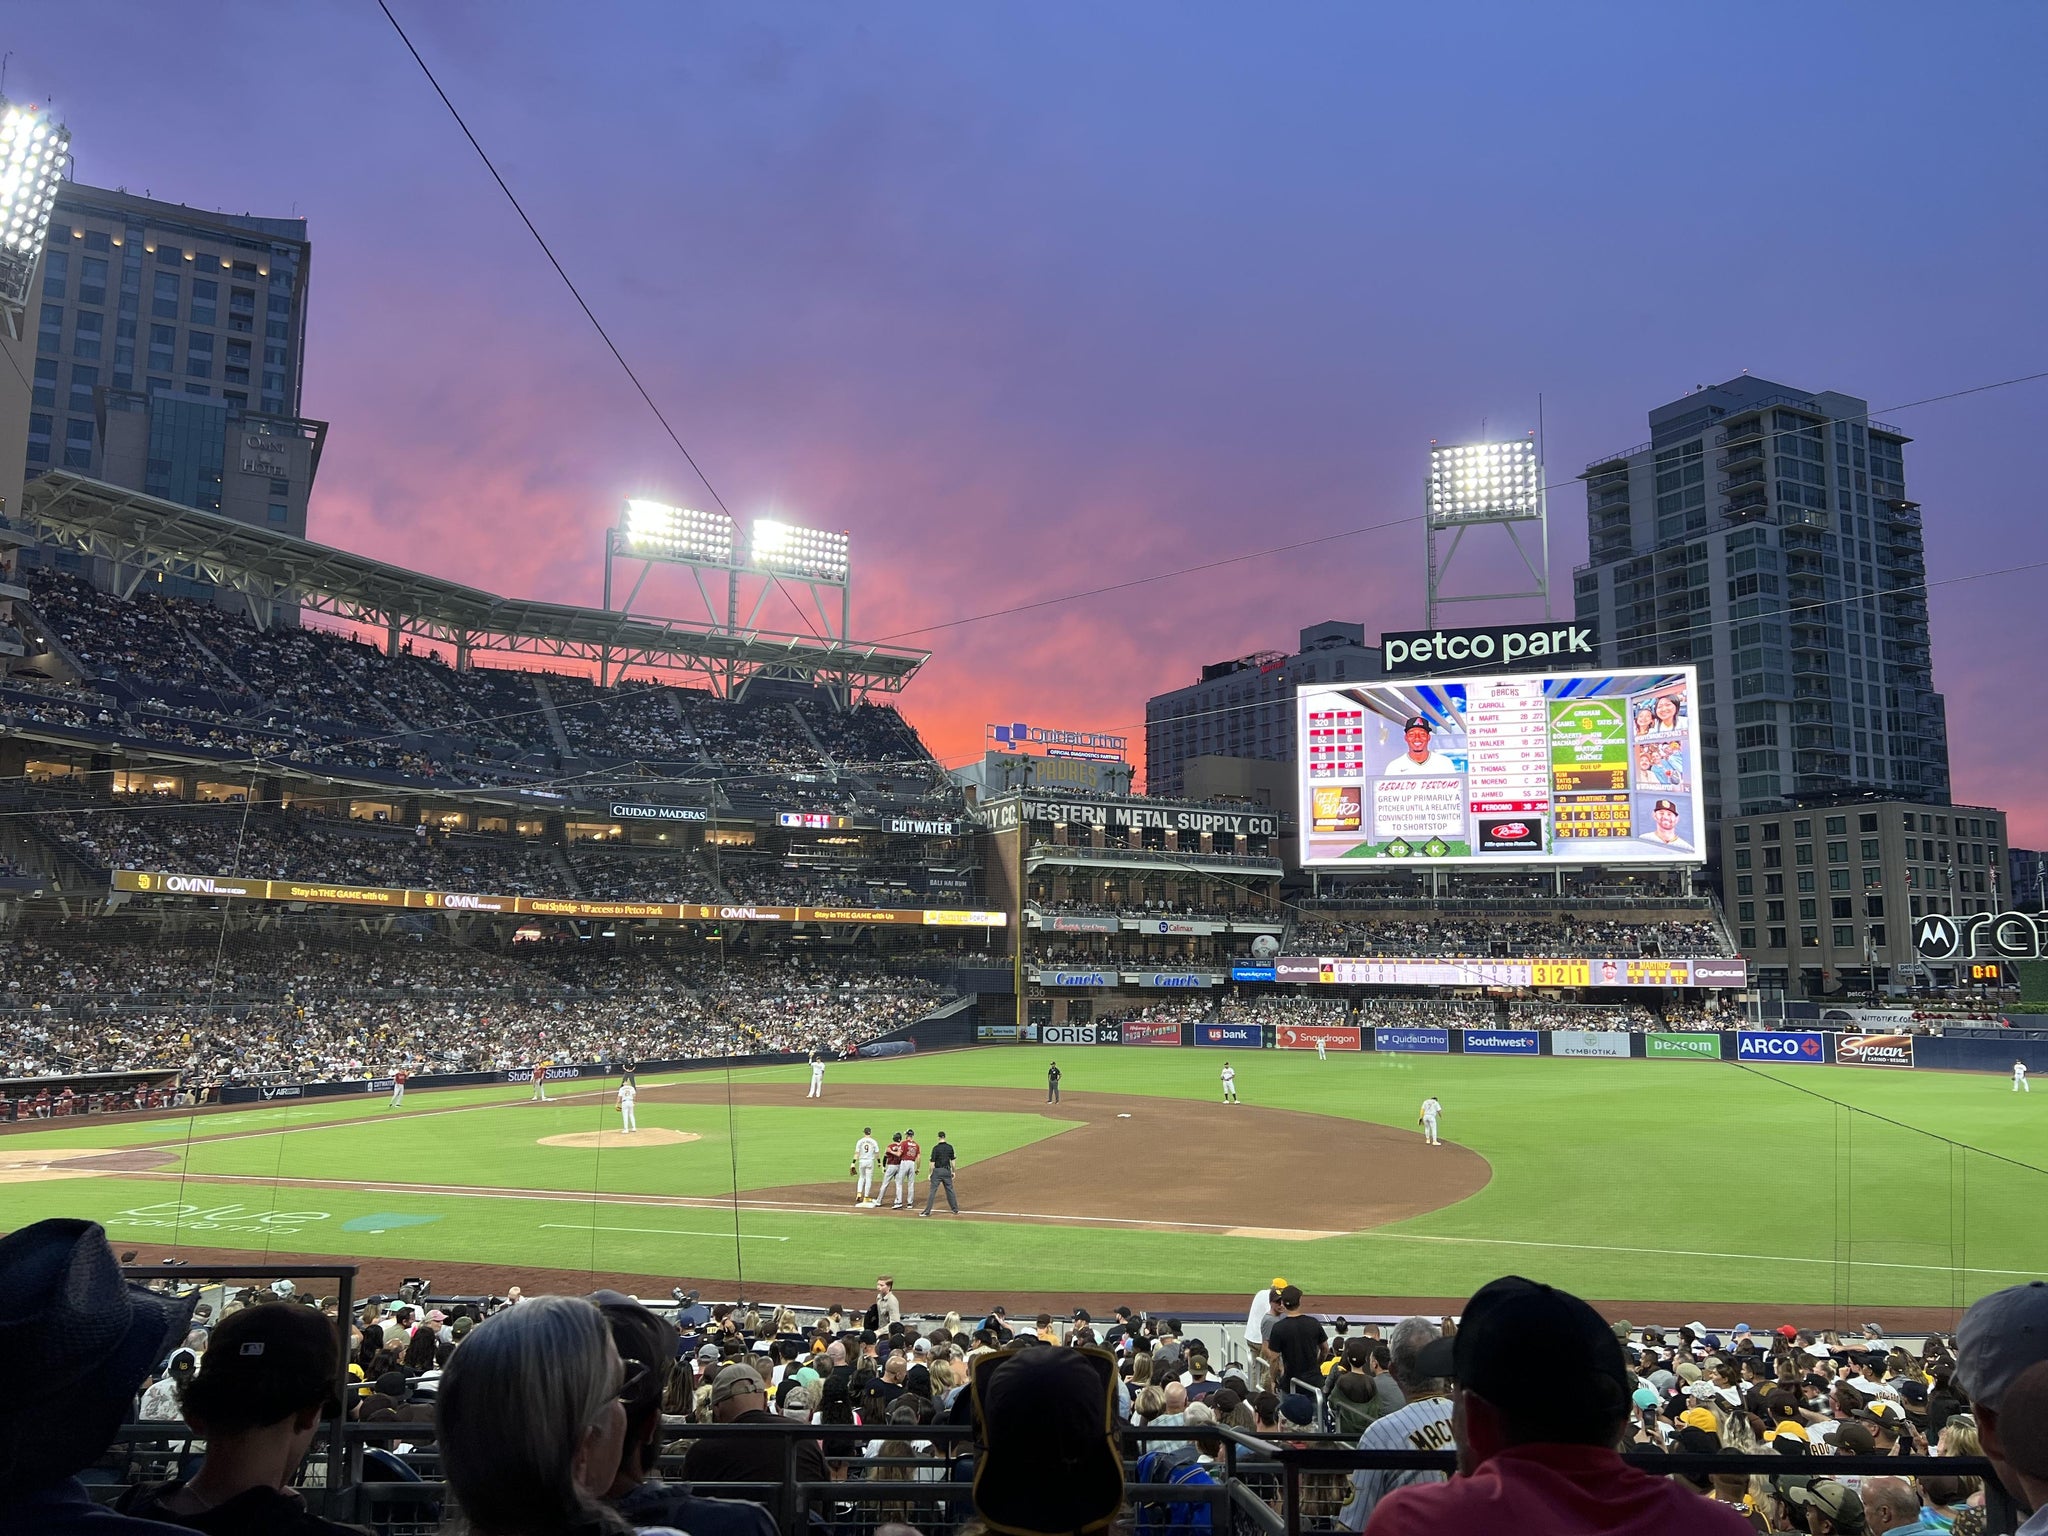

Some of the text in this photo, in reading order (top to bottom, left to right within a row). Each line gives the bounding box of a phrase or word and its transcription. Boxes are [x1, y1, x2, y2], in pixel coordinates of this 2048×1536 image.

[1386, 627, 1592, 670] petco park
[1071, 751, 1100, 759] DIAGNOSTICS
[1036, 761, 1097, 787] PADRES
[1378, 781, 1459, 791] GERALDO PERDOMO
[613, 806, 705, 819] CIUDAD MADERAS
[1322, 803, 1359, 815] BOARD
[1021, 803, 1277, 835] WESTERN METAL SUPPLY CO.
[892, 820, 952, 834] CUTWATER
[1560, 829, 1570, 837] 35
[1598, 828, 1608, 836] 29
[1617, 828, 1627, 836] 79
[1432, 845, 1439, 853] K
[167, 876, 214, 893] OMNI
[292, 887, 388, 901] Stay in THE GAME with Us
[445, 895, 477, 908] OMNI
[550, 902, 577, 913] Skybridge
[581, 904, 590, 913] VIP
[590, 906, 613, 914] access
[615, 906, 623, 914] to
[625, 905, 645, 914] Petco
[647, 905, 663, 915] Park
[721, 907, 756, 919] OMNI
[814, 911, 829, 919] Stay
[872, 912, 883, 920] with
[1169, 923, 1193, 932] Calimax
[1966, 911, 2048, 960] ra
[1639, 962, 1671, 970] MARTINEZ
[1055, 973, 1104, 985] Canel's
[1154, 974, 1199, 986] Canel's
[1538, 968, 1582, 984] 3 2 1
[1633, 976, 1638, 984] 3
[1029, 985, 1045, 998] 336
[1045, 1028, 1094, 1042] ORIS
[1100, 1030, 1118, 1041] 342
[1222, 1029, 1247, 1039] bank
[1392, 1035, 1445, 1045] QuidelOrtho
[1468, 1036, 1526, 1047] Southwest
[1740, 1038, 1798, 1054] ARCO
[1565, 1048, 1616, 1056] CYMBIOTIKA
[1840, 1037, 1905, 1062] Sycuan
[508, 1069, 579, 1082] StubH StubHub
[864, 1144, 869, 1153] 9
[115, 1201, 331, 1224] blue
[106, 1218, 301, 1234] california
[1408, 1419, 1454, 1450] MAC
